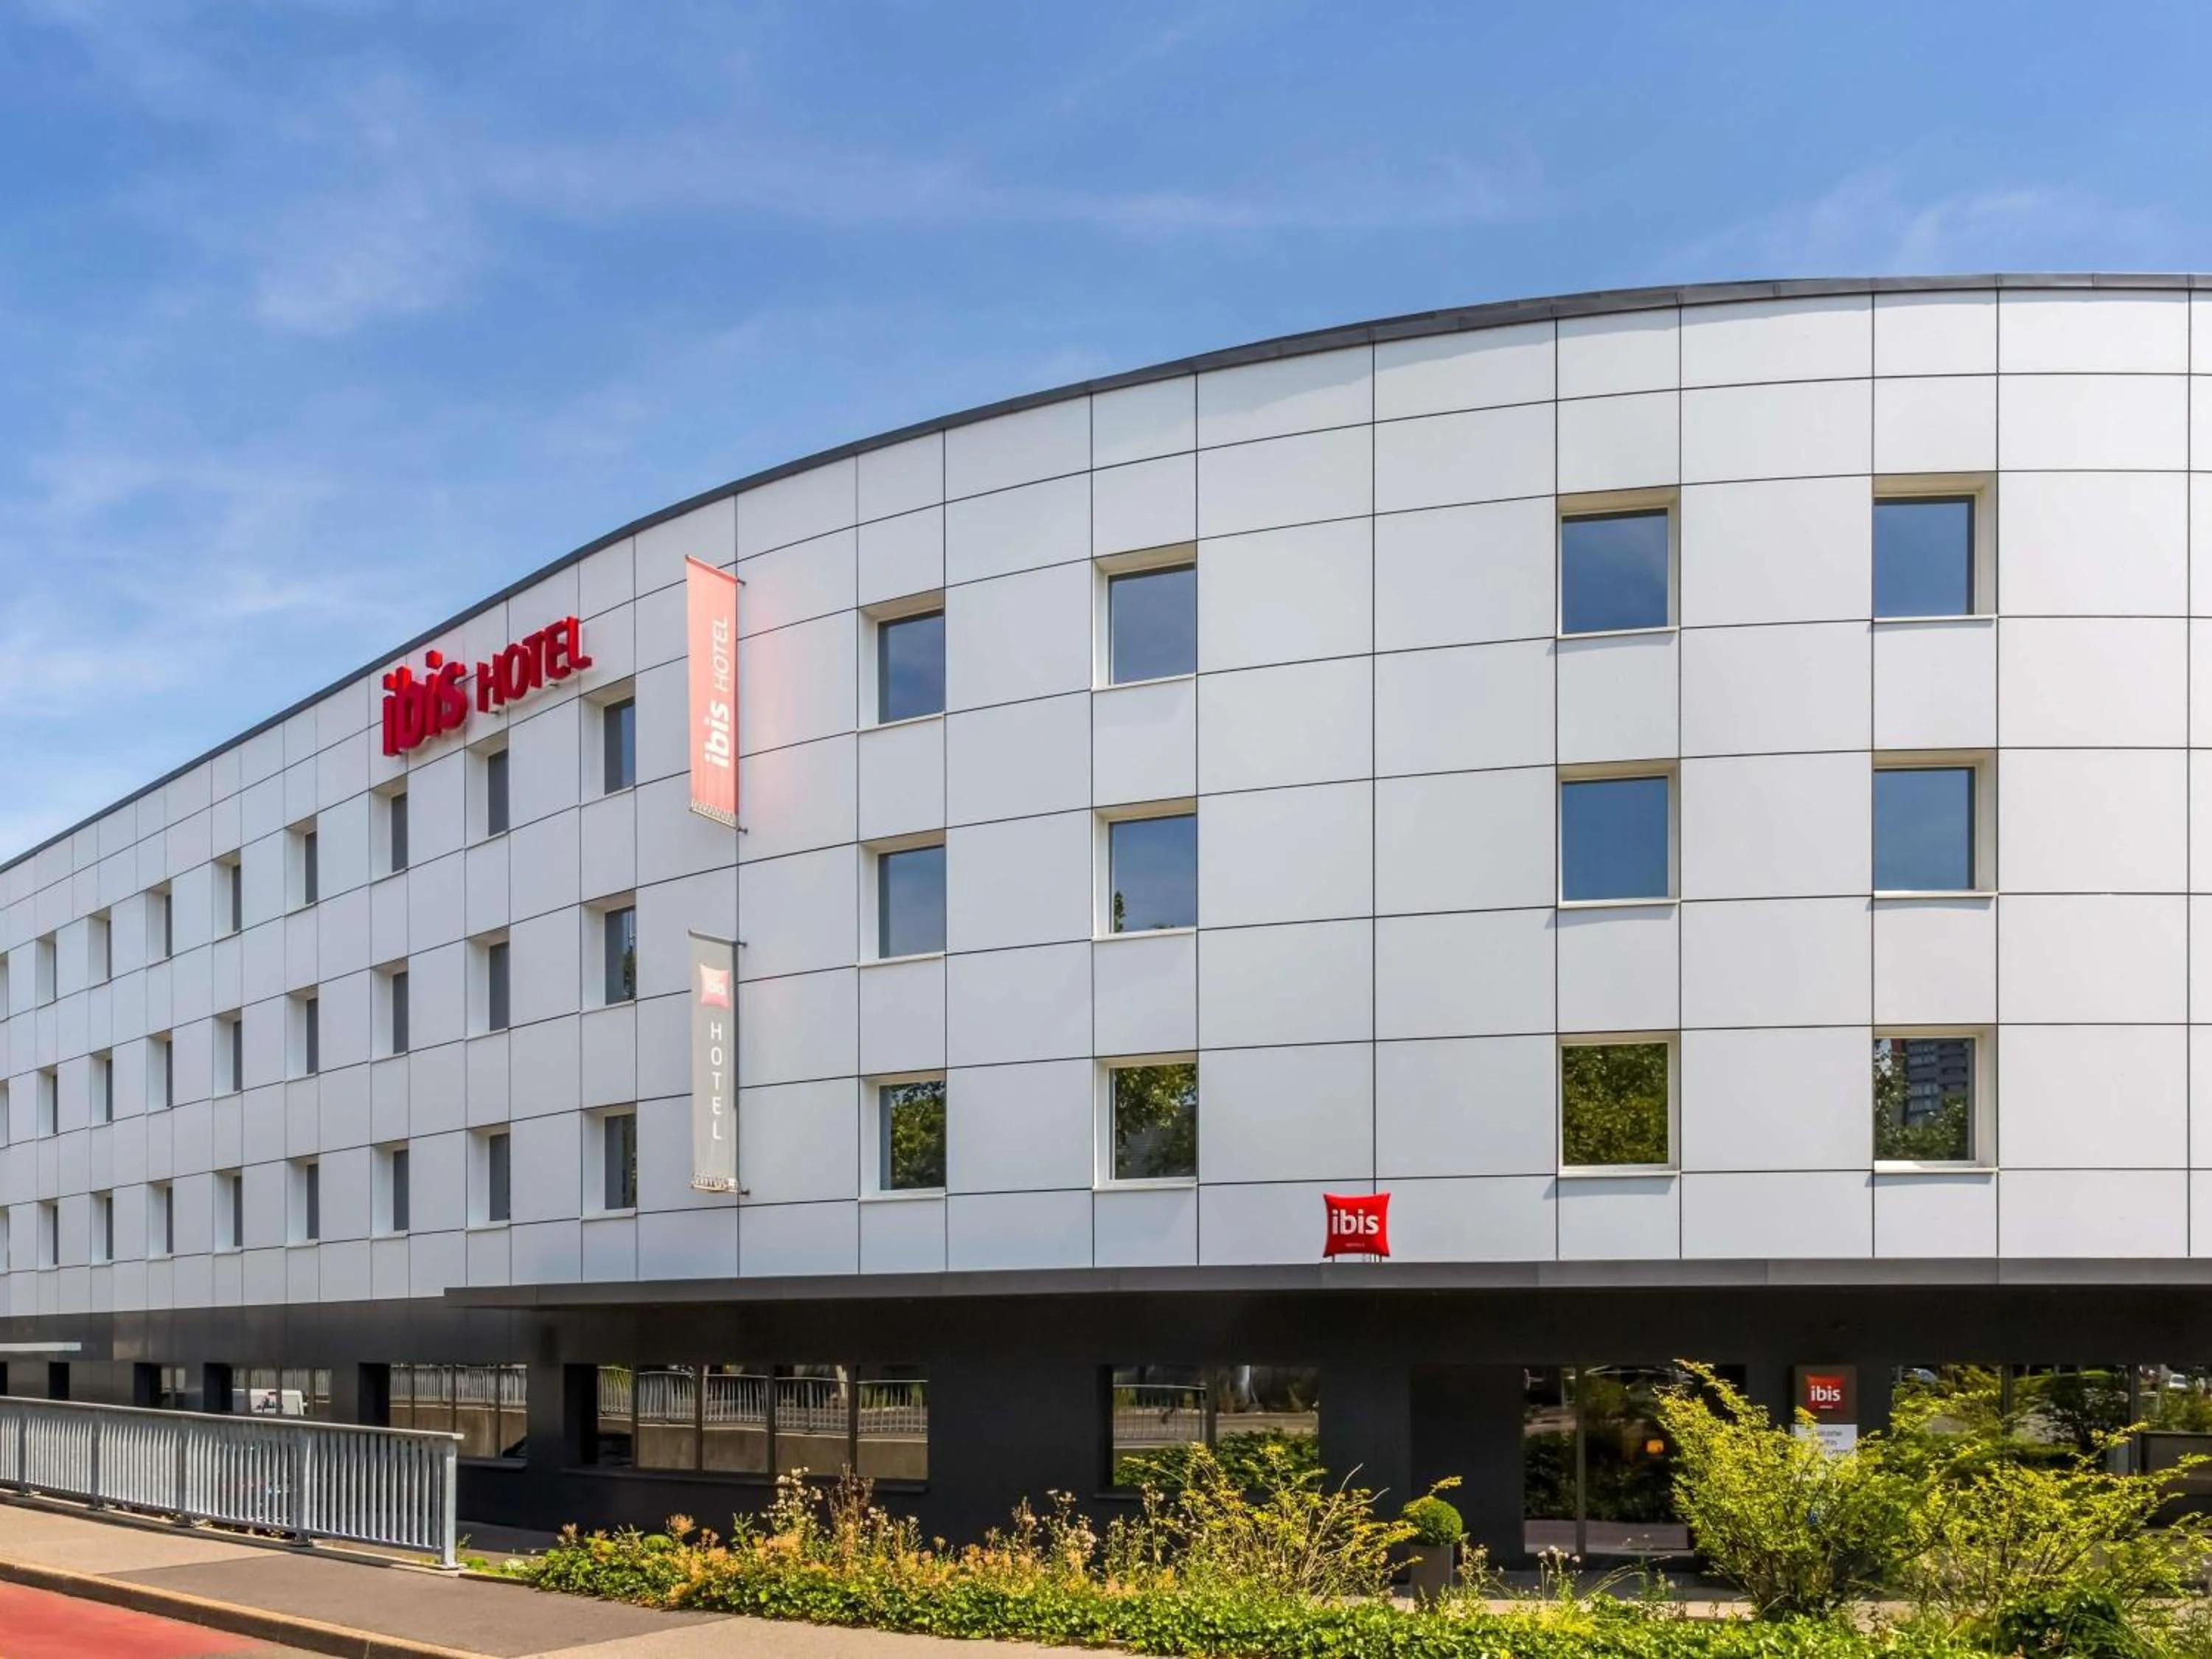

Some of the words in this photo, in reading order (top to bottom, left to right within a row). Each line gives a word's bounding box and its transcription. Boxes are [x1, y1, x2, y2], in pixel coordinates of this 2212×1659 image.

[383, 650, 468, 757] ibis
[476, 616, 593, 714] HOTEL
[712, 615, 728, 693] HOTEL
[703, 700, 729, 768] ibis
[710, 1020, 722, 1140] HOTEL
[1332, 1208, 1380, 1235] ibis
[1810, 1385, 1841, 1402] ibis
